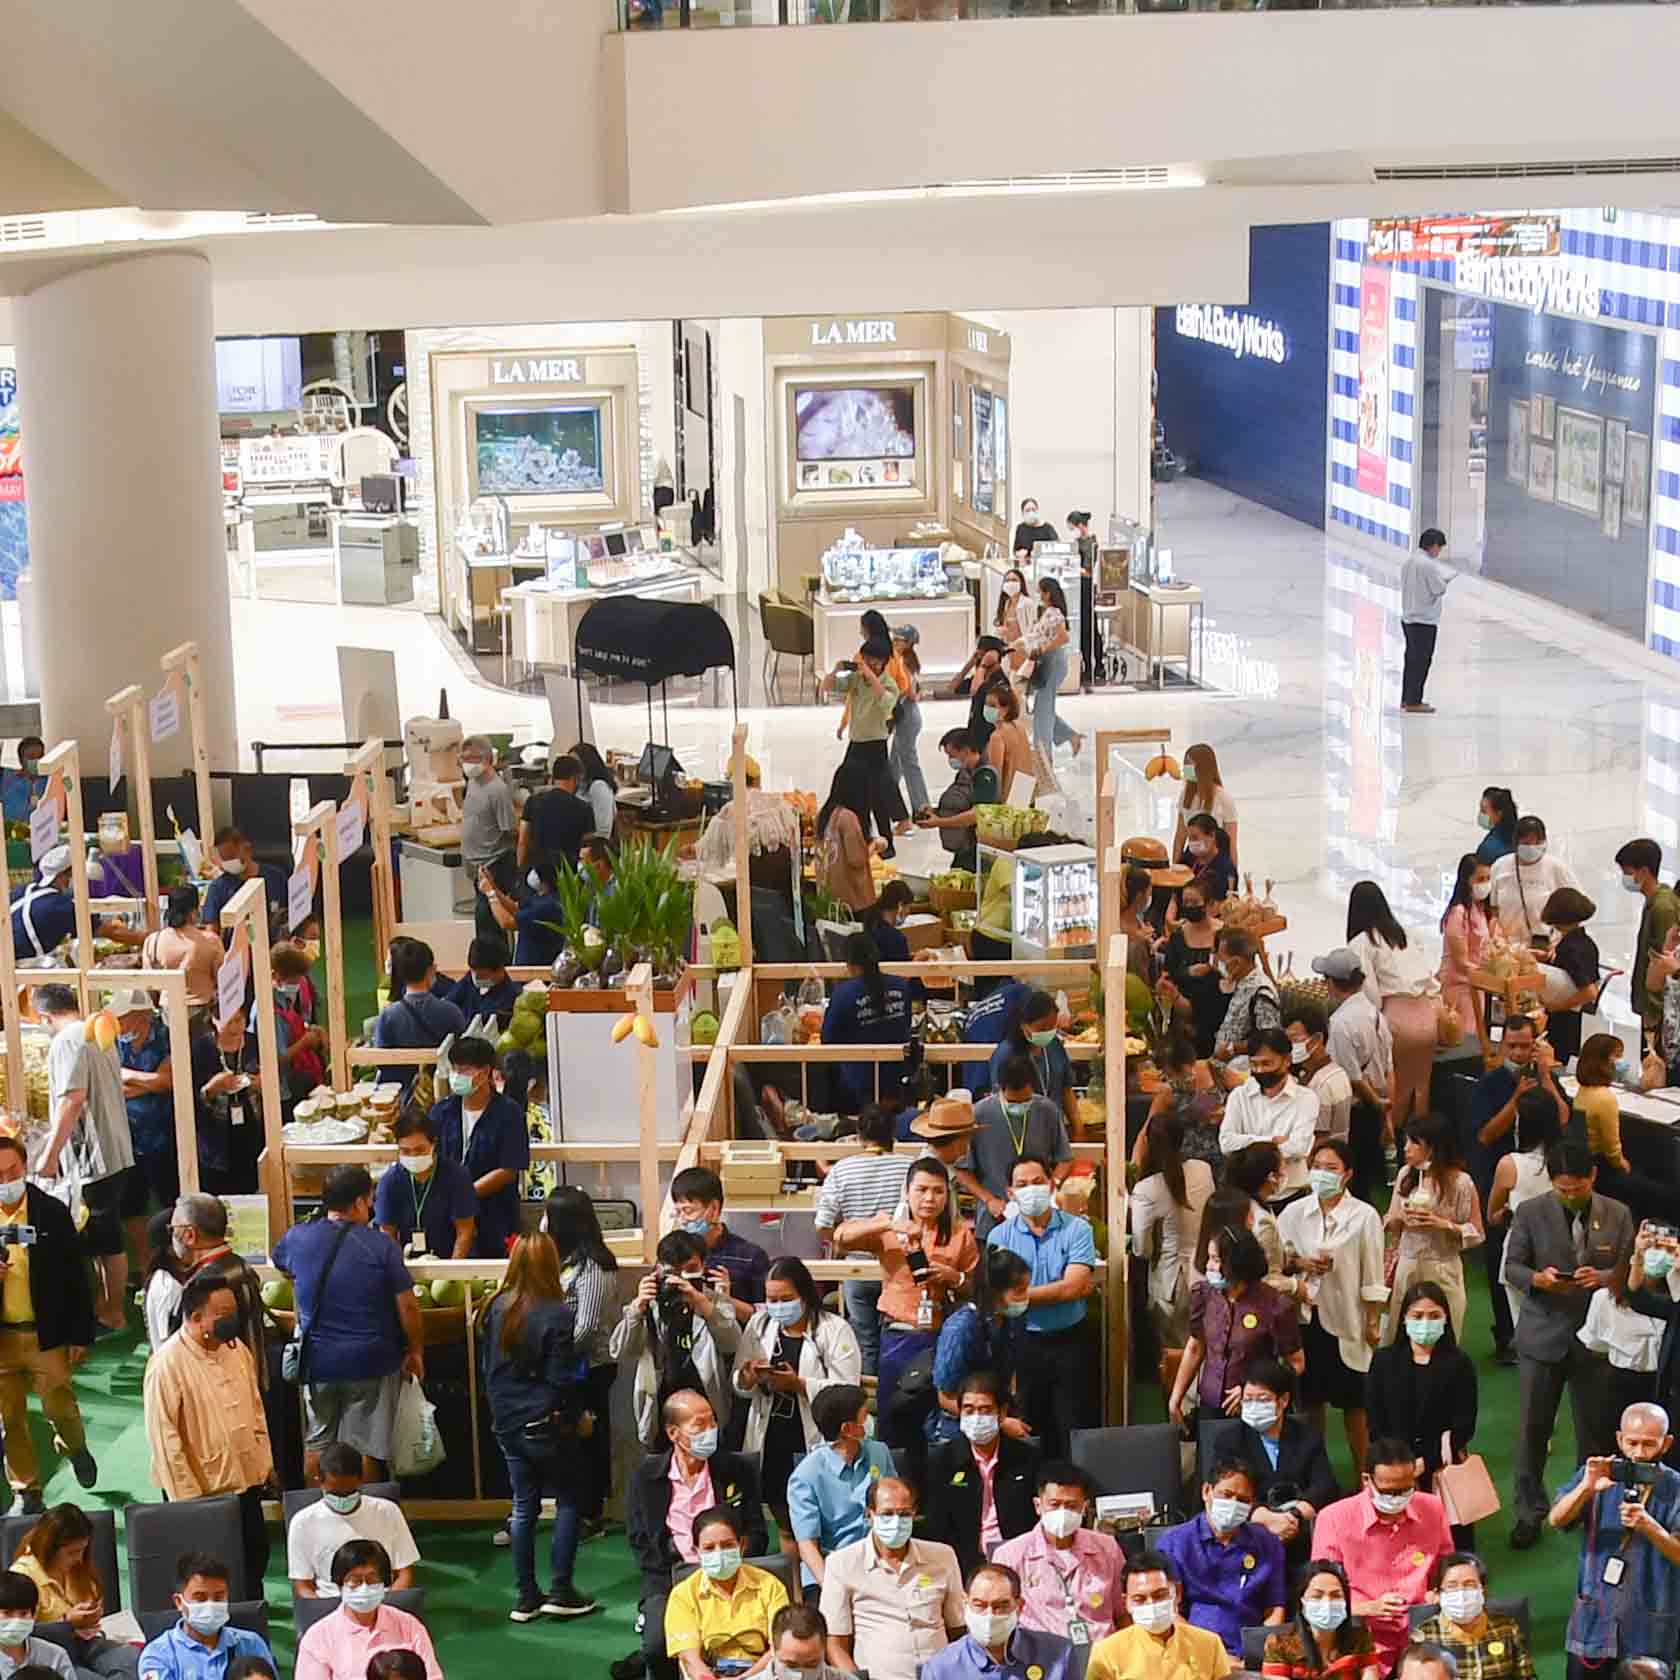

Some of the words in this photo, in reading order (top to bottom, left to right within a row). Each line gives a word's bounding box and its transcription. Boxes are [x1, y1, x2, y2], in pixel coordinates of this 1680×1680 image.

[811, 323, 844, 345] LA
[845, 320, 897, 343] MER
[492, 361, 526, 383] LA
[528, 359, 582, 382] MER
